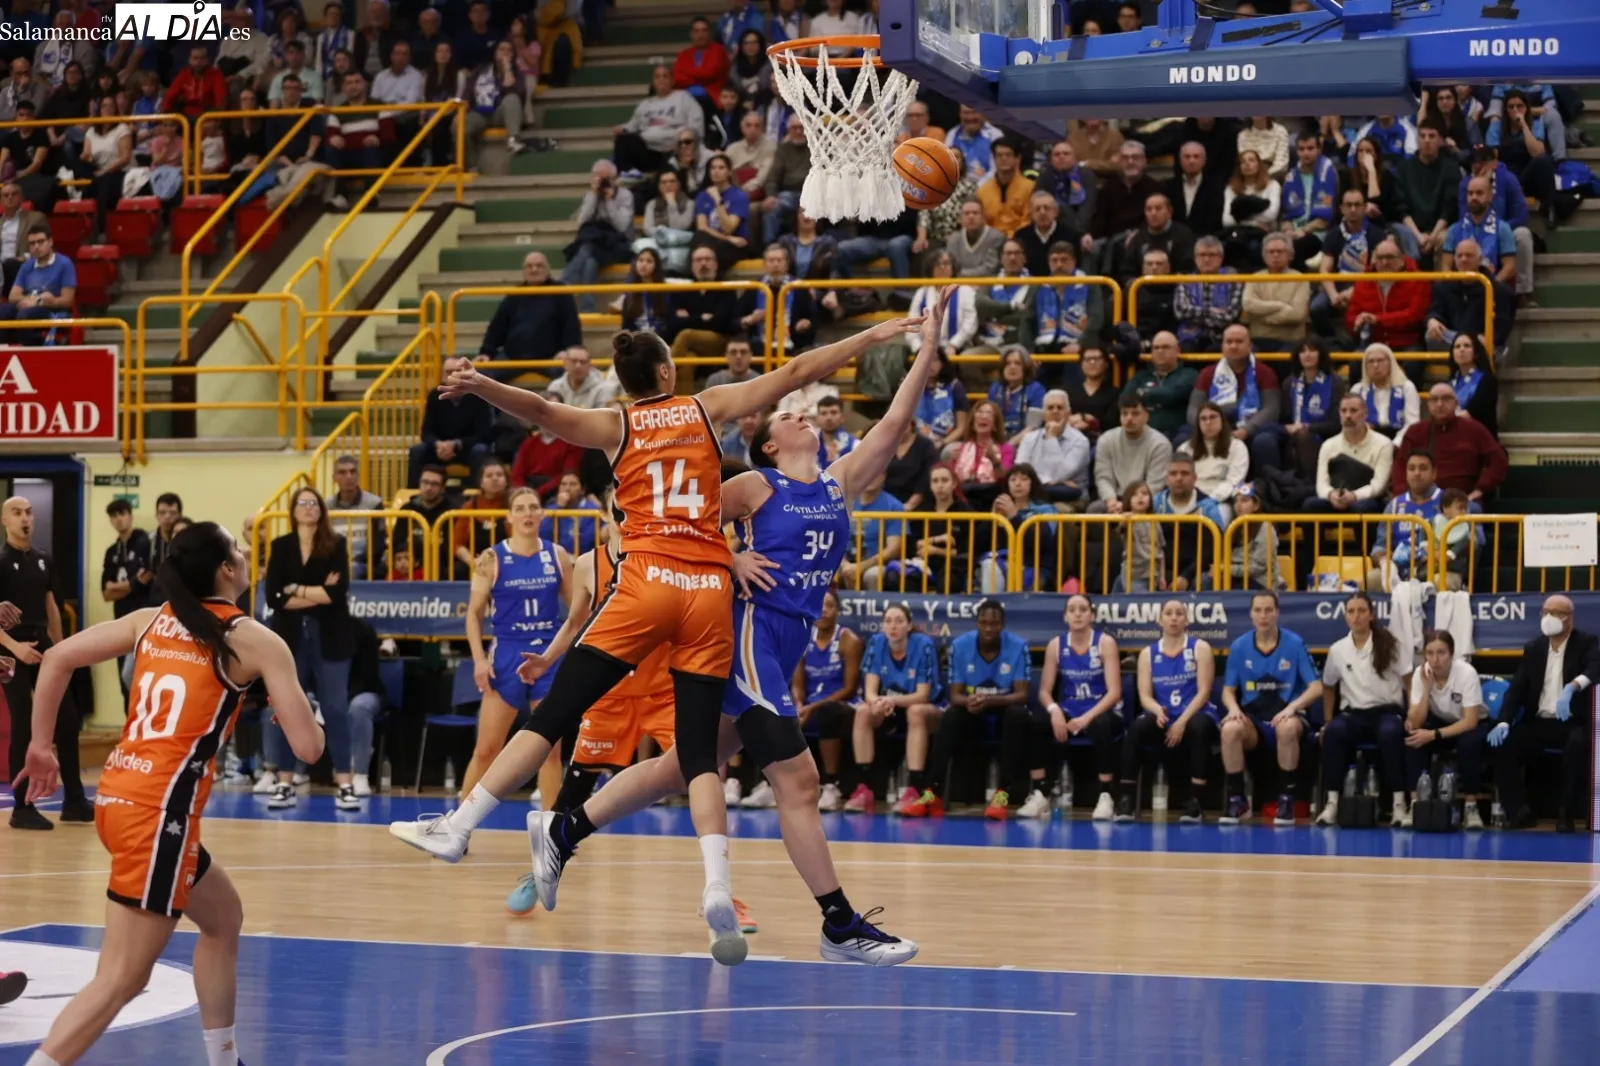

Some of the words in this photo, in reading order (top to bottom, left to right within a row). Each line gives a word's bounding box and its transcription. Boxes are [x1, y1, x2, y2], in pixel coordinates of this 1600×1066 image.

[1470, 38, 1559, 56] MONDO
[1169, 64, 1256, 84] MONDO
[0, 401, 101, 434] IDAD
[631, 405, 702, 431] CARRERA
[646, 459, 705, 520] 14
[802, 530, 834, 560] 34
[646, 565, 722, 591] PAMESA
[525, 598, 539, 617] 11
[924, 600, 938, 620] Y
[1186, 628, 1228, 639] umanidad
[127, 672, 187, 742] 10
[1169, 690, 1182, 707] 6
[581, 739, 613, 749] PULEVA
